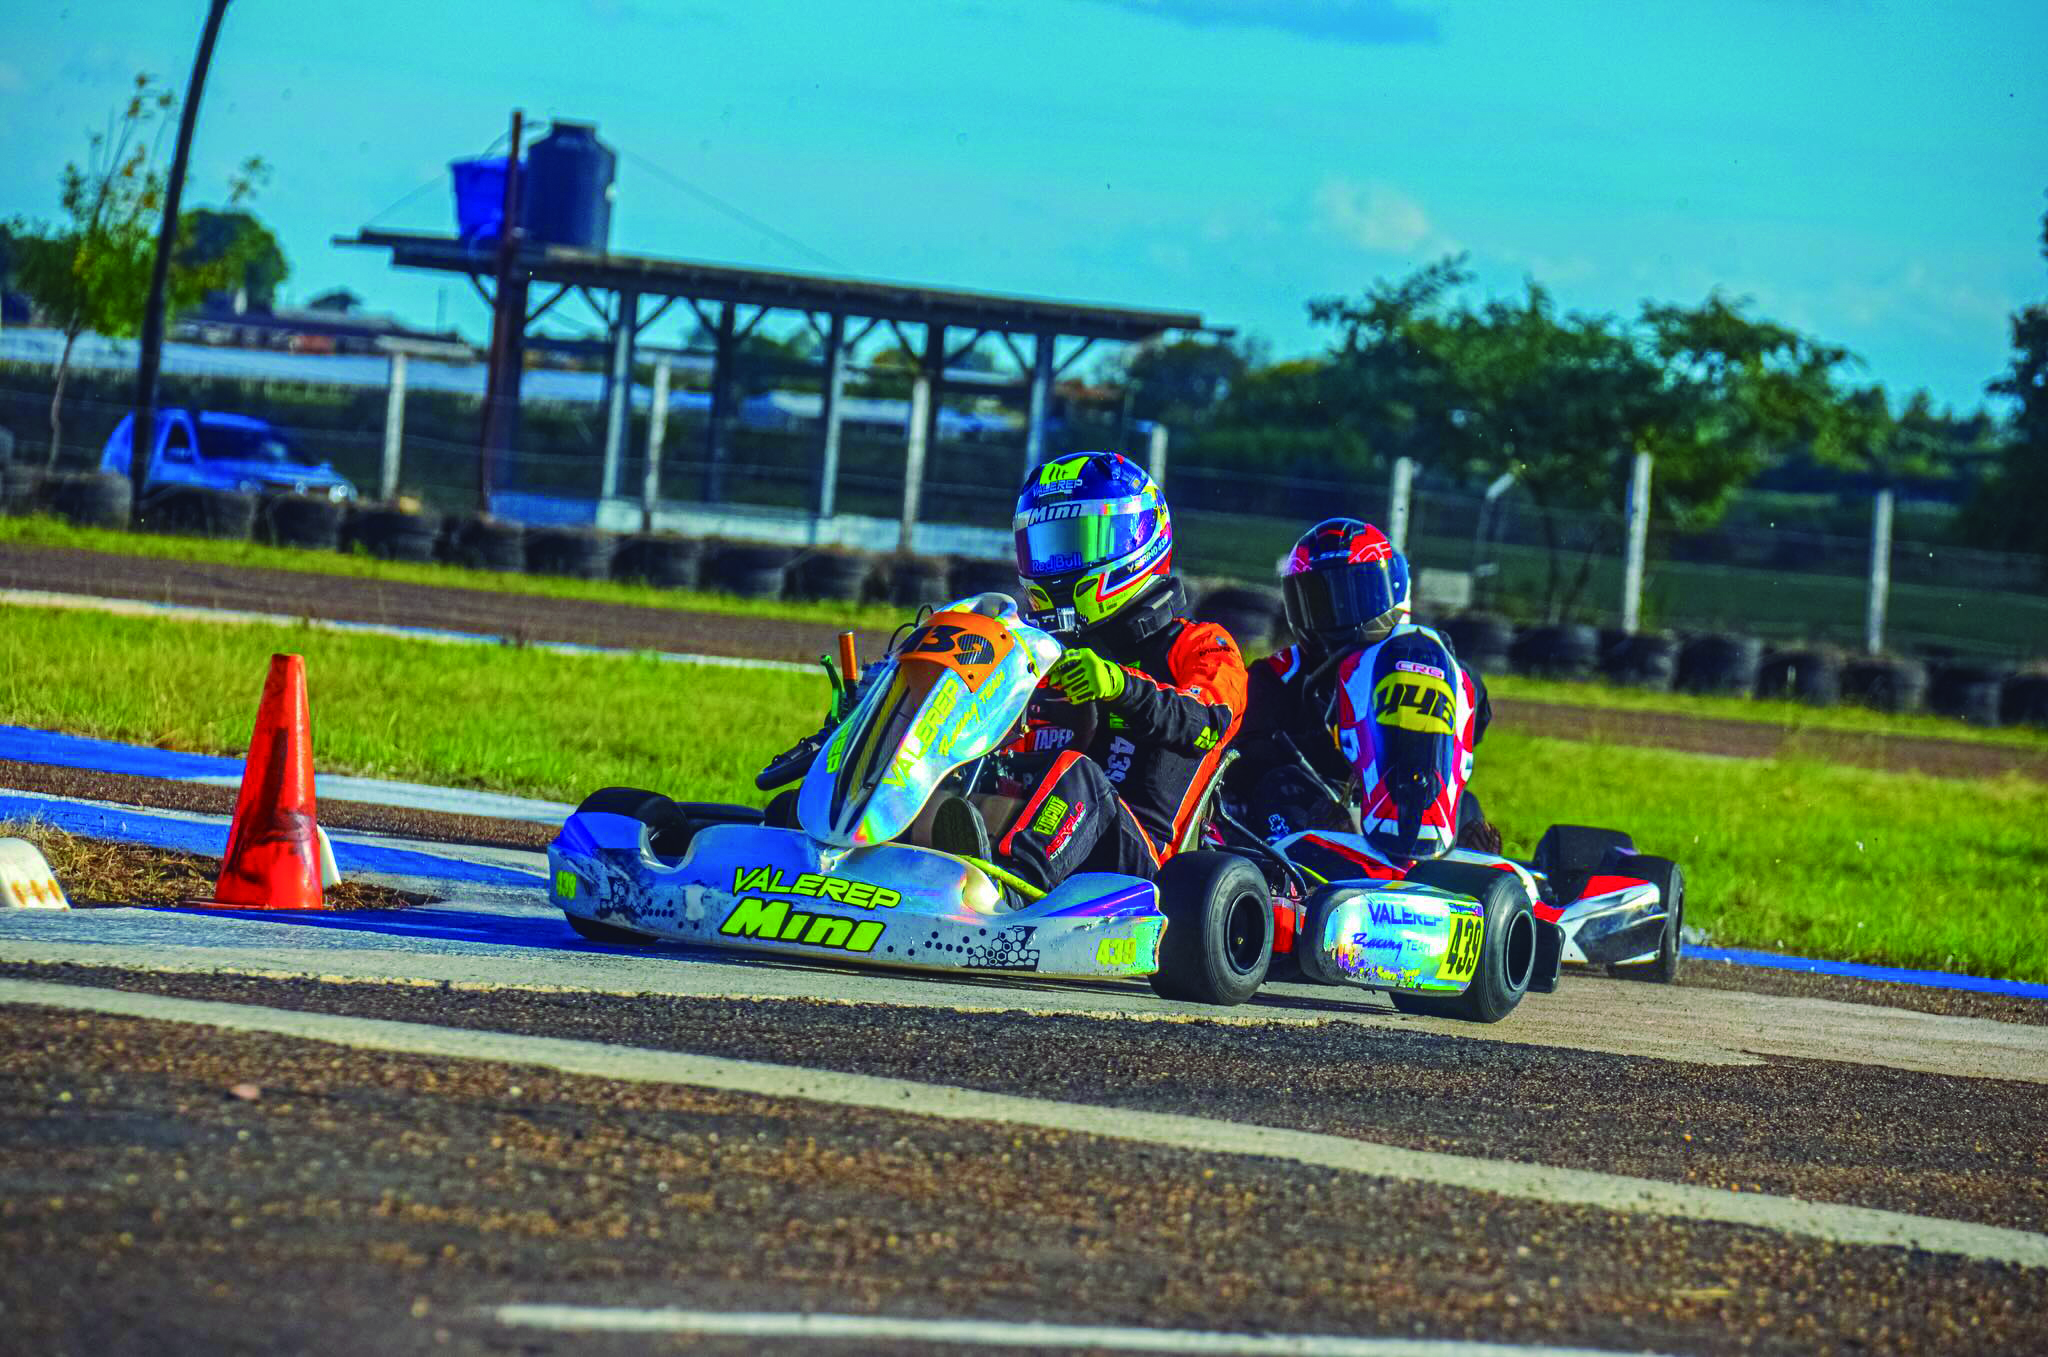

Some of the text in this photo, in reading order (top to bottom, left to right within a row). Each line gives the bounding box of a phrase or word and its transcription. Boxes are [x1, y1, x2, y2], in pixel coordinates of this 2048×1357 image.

[1029, 503, 1082, 526] Mini
[1032, 552, 1082, 572] Red Bull
[882, 677, 959, 787] VALEREP
[1104, 736, 1136, 783] 439
[732, 864, 902, 910] VALEREP
[1368, 903, 1443, 926] VALEREP
[1096, 937, 1136, 965] 439
[1352, 933, 1430, 961] Racing TEAM
[1446, 917, 1482, 975] 439
